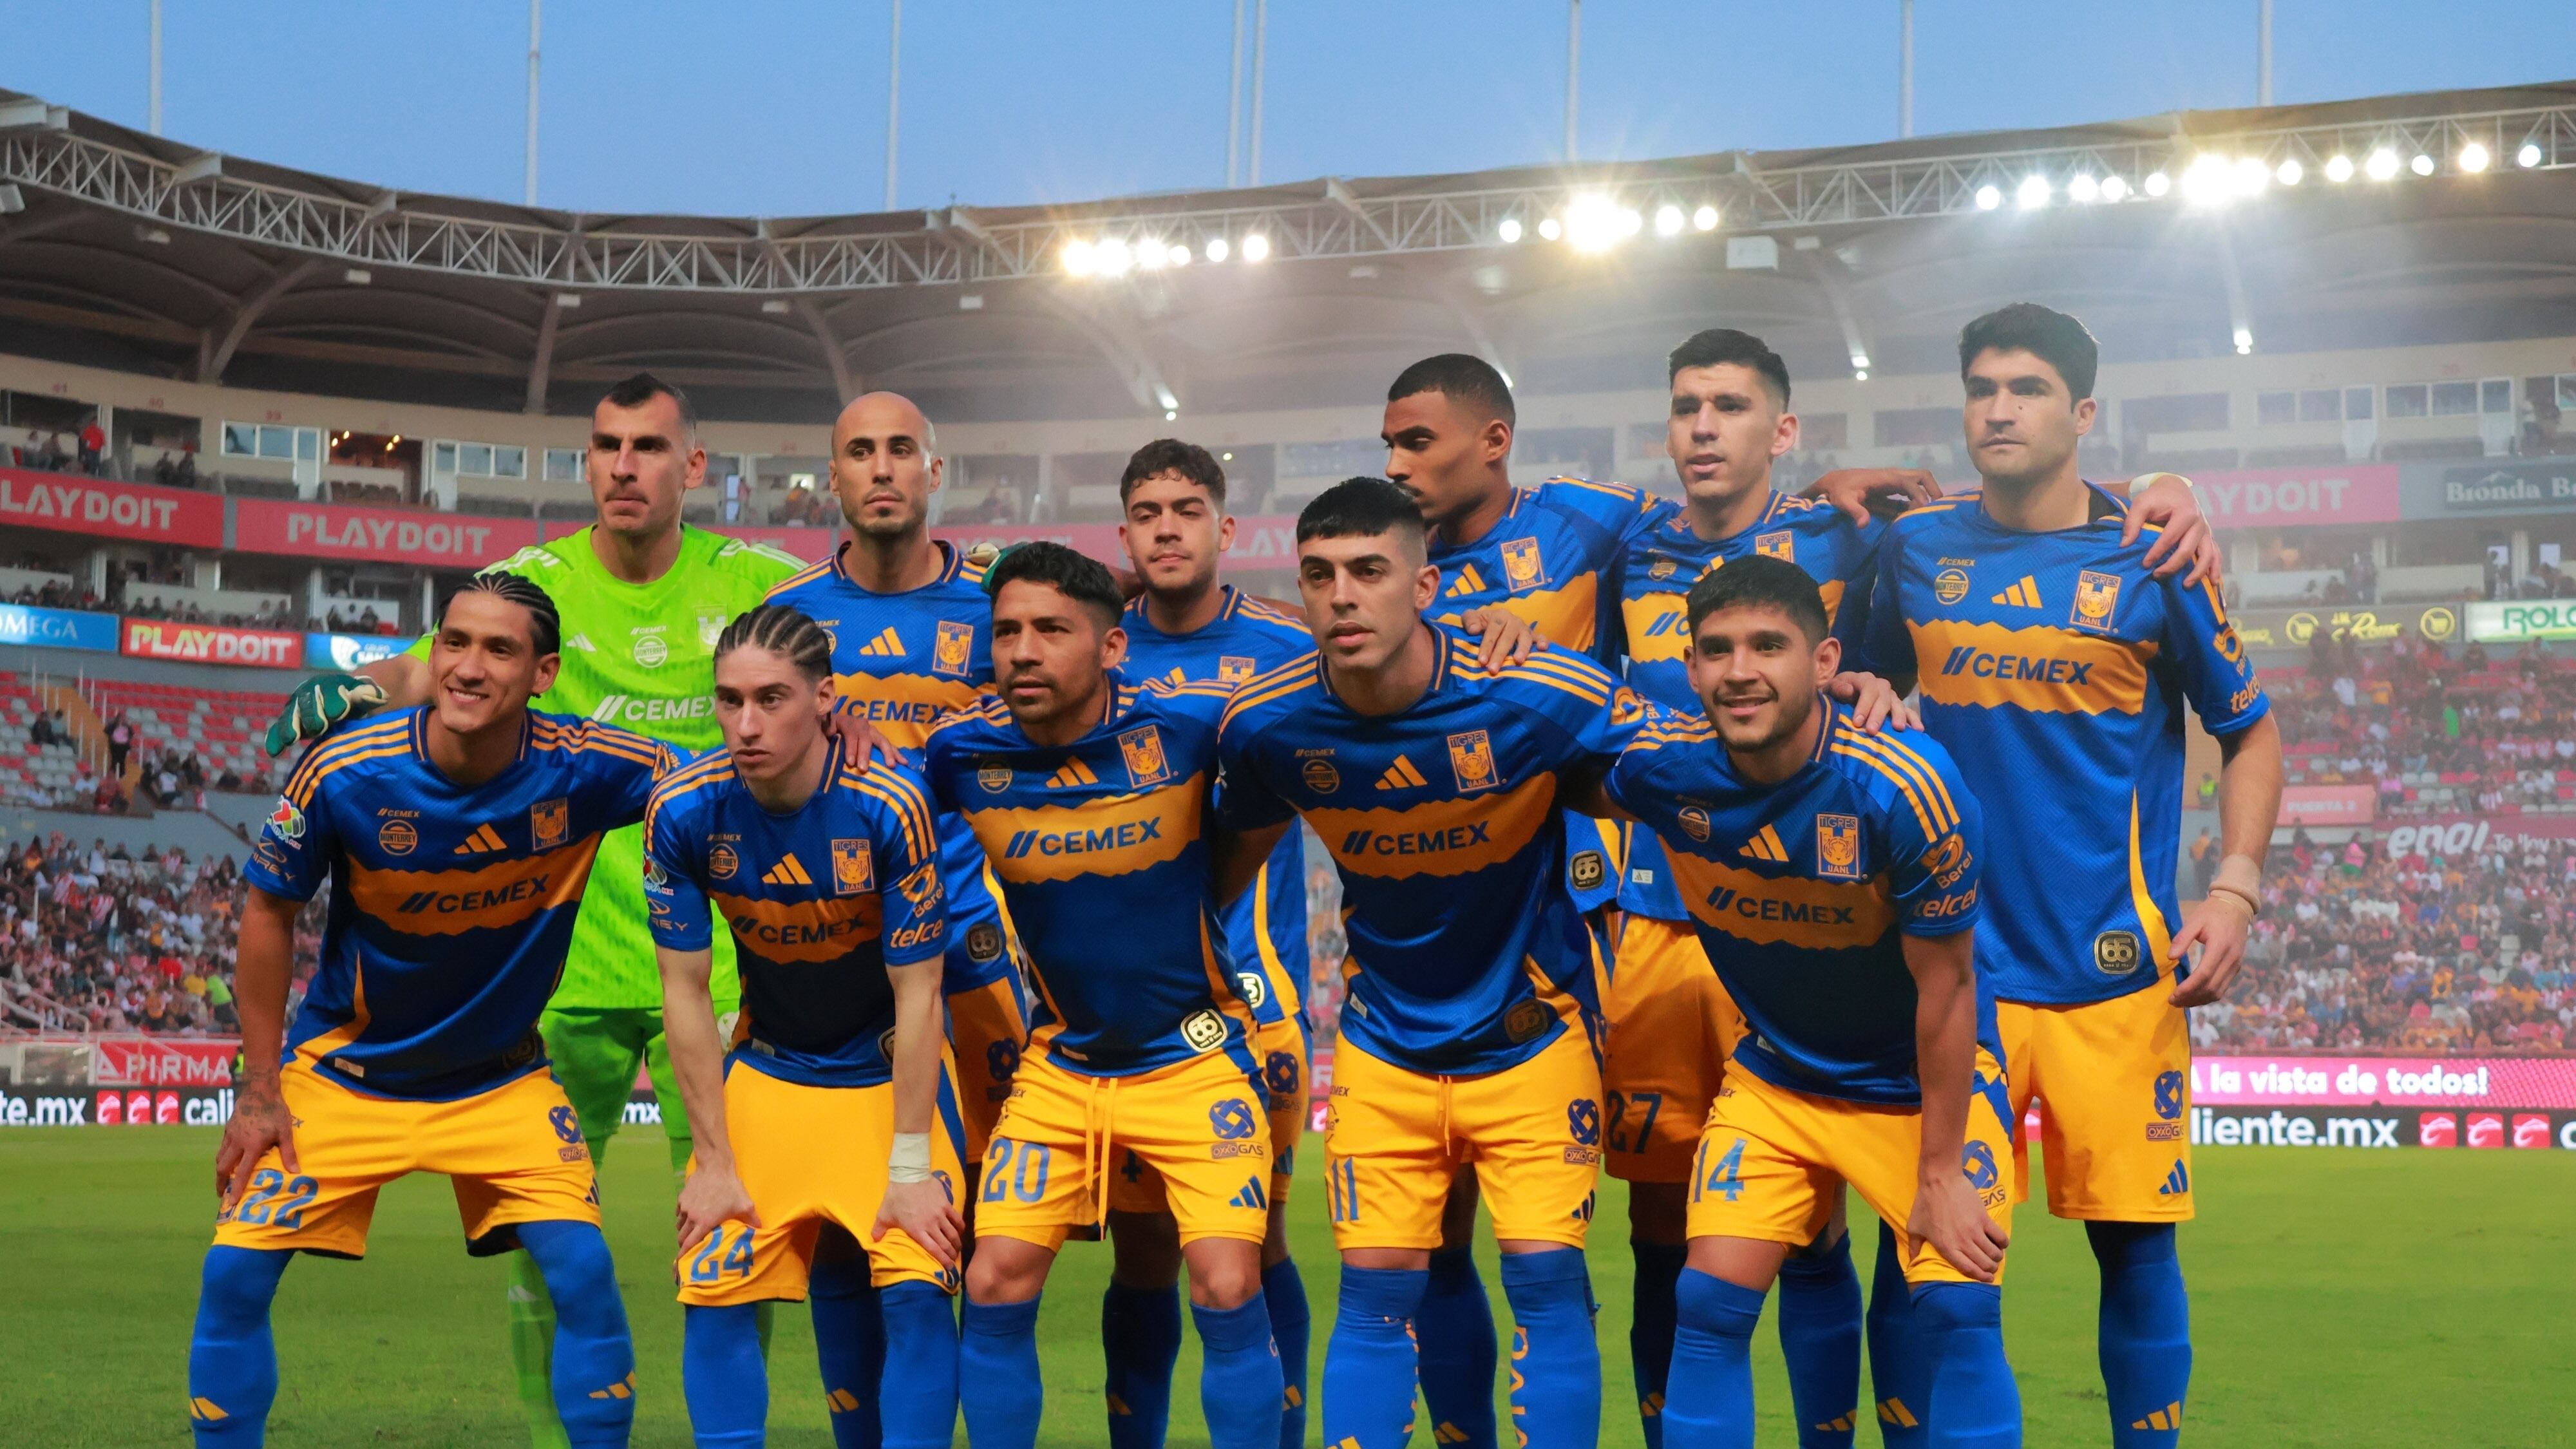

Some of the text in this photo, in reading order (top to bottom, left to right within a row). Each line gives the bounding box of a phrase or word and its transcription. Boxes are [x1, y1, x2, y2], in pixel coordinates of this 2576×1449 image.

[287, 513, 491, 556] PLAYDOIT
[1757, 533, 1791, 547] TIGRES
[1946, 558, 1976, 567] CEMEX
[2082, 574, 2119, 587] TIGRES
[0, 611, 78, 640] MEGA
[940, 624, 972, 636] TIGRES
[2079, 616, 2102, 627] UANL
[130, 624, 292, 663] PLAYDOIT
[1972, 653, 2094, 685] CEMEX
[1121, 727, 1157, 744] TIGRES
[1450, 732, 1486, 748] TIGRES
[1139, 772, 1162, 784] UANL
[1466, 777, 1490, 788] UANL
[387, 810, 421, 819] CEMEX
[1819, 817, 1856, 829] TIGRES
[834, 840, 869, 851] TIGRES
[1039, 816, 1162, 857] CEMEX
[1374, 820, 1491, 856] CEMEX
[1827, 864, 1850, 875] UANL
[1937, 850, 1973, 889] Berel
[435, 873, 549, 914] CEMEX
[844, 883, 865, 892] UANL
[1913, 878, 1979, 918] telcel
[1736, 897, 1856, 925] CEMEX
[759, 911, 863, 945] CEMEX
[2101, 938, 2132, 962] 65
[126, 1054, 232, 1084] PIRMA
[2210, 1064, 2241, 1094] la
[2248, 1064, 2328, 1094] vista
[2335, 1064, 2378, 1095] de
[2385, 1065, 2489, 1096] todos!
[1606, 1089, 1663, 1155] 27
[983, 1137, 1051, 1203] 20
[1693, 1137, 1745, 1204] 14
[238, 1168, 319, 1229] 22
[1331, 1157, 1360, 1222] 11
